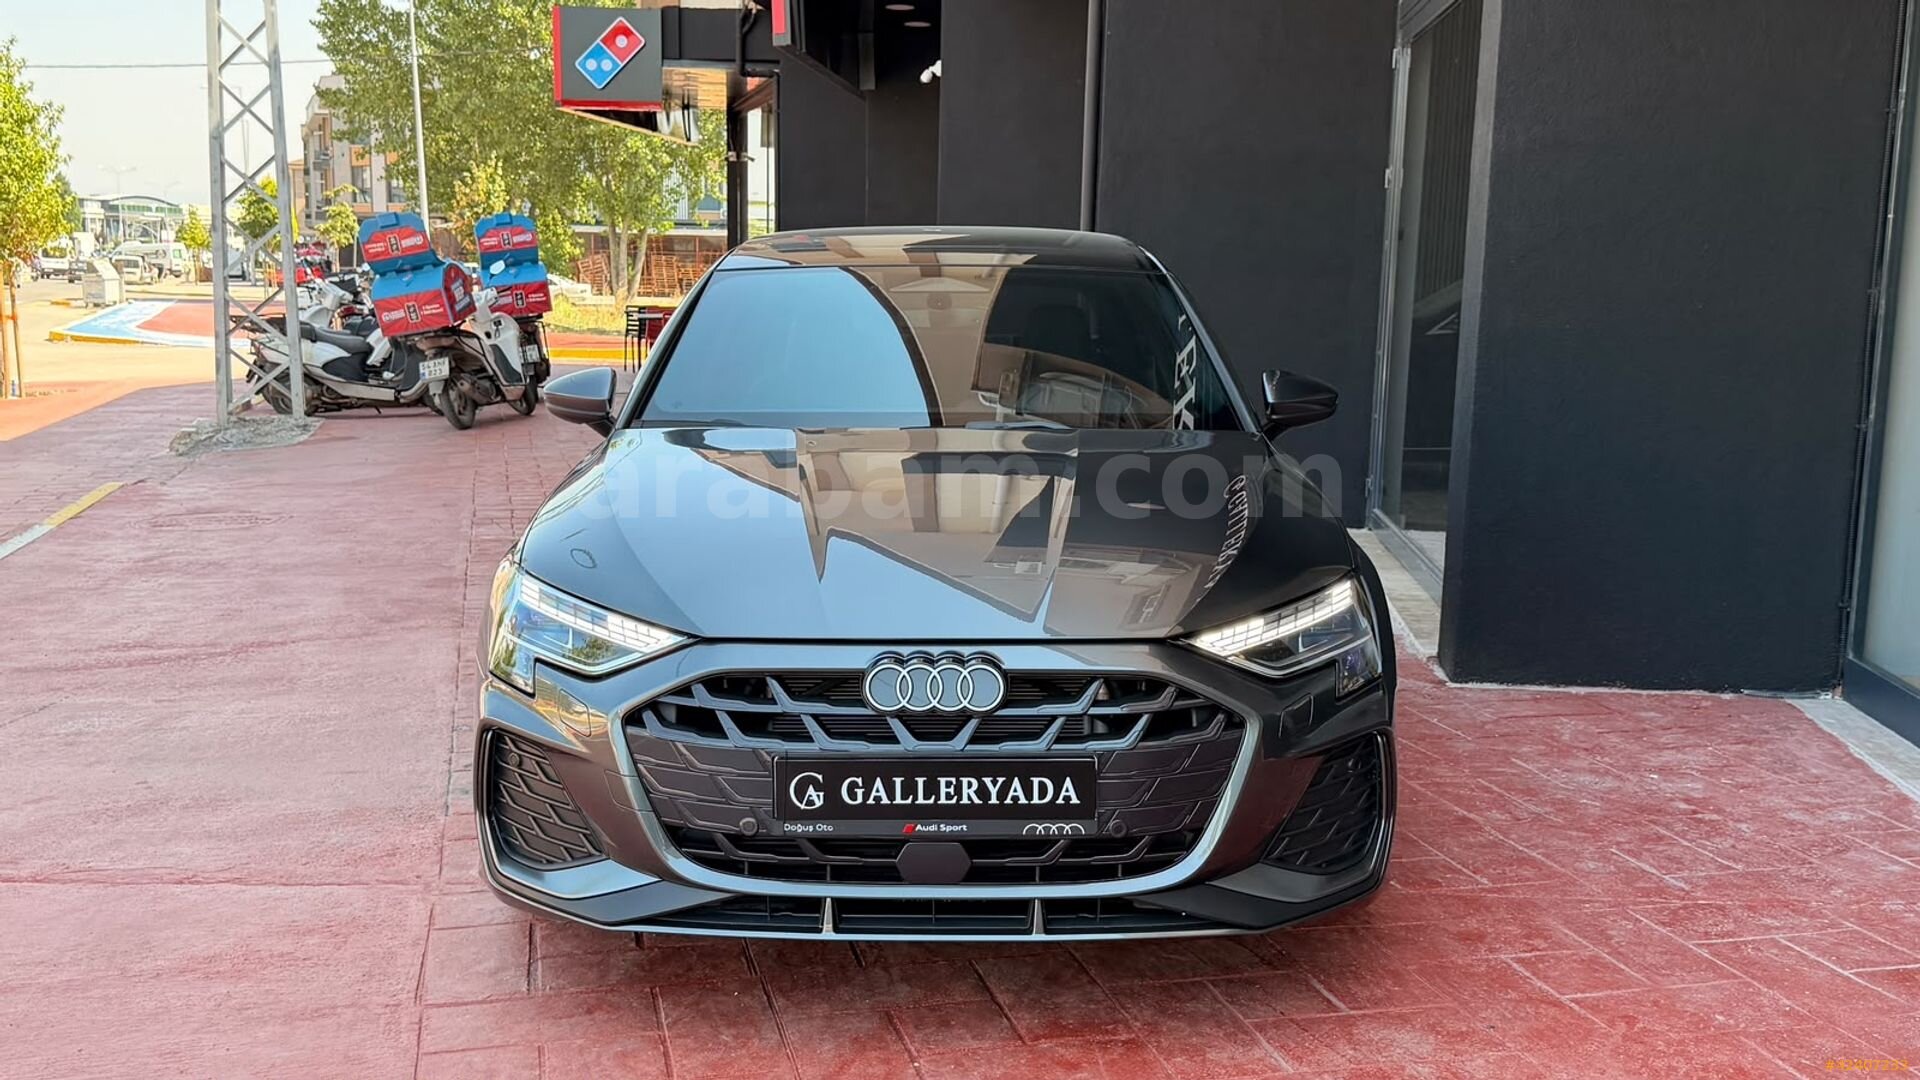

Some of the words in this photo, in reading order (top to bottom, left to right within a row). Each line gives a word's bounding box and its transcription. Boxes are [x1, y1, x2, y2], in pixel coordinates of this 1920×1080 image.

[841, 776, 1081, 805] GALLERYADA
[783, 823, 814, 833] Doğuş
[815, 823, 834, 832] Oto
[915, 823, 938, 832] Audi
[940, 823, 968, 833] Sport
